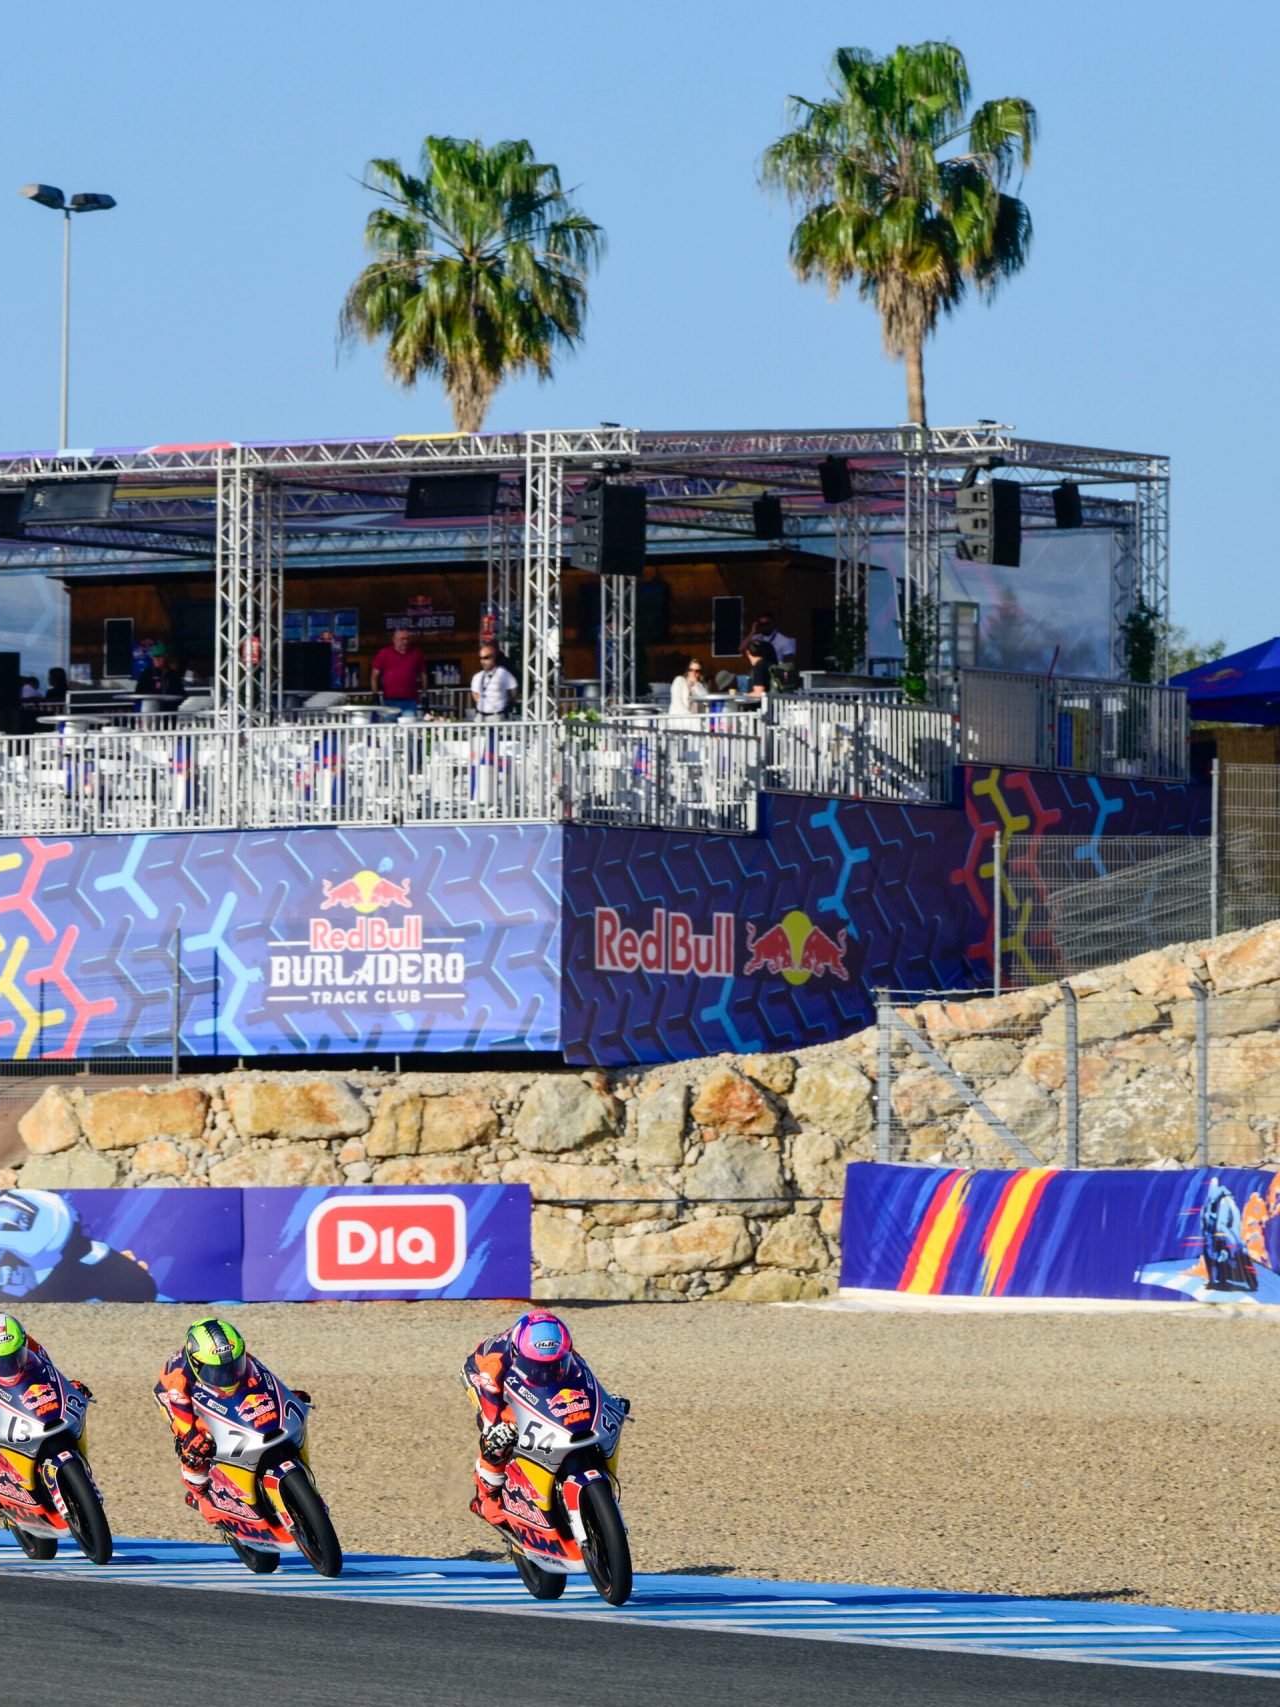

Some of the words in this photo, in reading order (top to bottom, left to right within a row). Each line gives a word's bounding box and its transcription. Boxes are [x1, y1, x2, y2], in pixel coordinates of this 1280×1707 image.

[310, 916, 366, 952] Red
[368, 915, 422, 951] Bull
[595, 906, 666, 974] Red
[668, 911, 734, 978] Bull
[269, 953, 465, 987] BURLADERO
[311, 991, 368, 1004] TRACK
[375, 990, 421, 1003] CLUB
[215, 1344, 234, 1354] HJC
[539, 1341, 558, 1349] HJC
[241, 1407, 258, 1422] Red
[256, 1401, 275, 1416] Bull
[254, 1412, 277, 1428] KTM
[551, 1402, 572, 1417] Red
[570, 1400, 590, 1414] Bull
[564, 1411, 591, 1425] KTM
[7, 1415, 33, 1443] 13
[520, 1420, 556, 1455] 54
[228, 1430, 251, 1457] 7
[502, 1489, 523, 1515] Red
[519, 1499, 551, 1527] Bull
[513, 1525, 568, 1557] KTM
